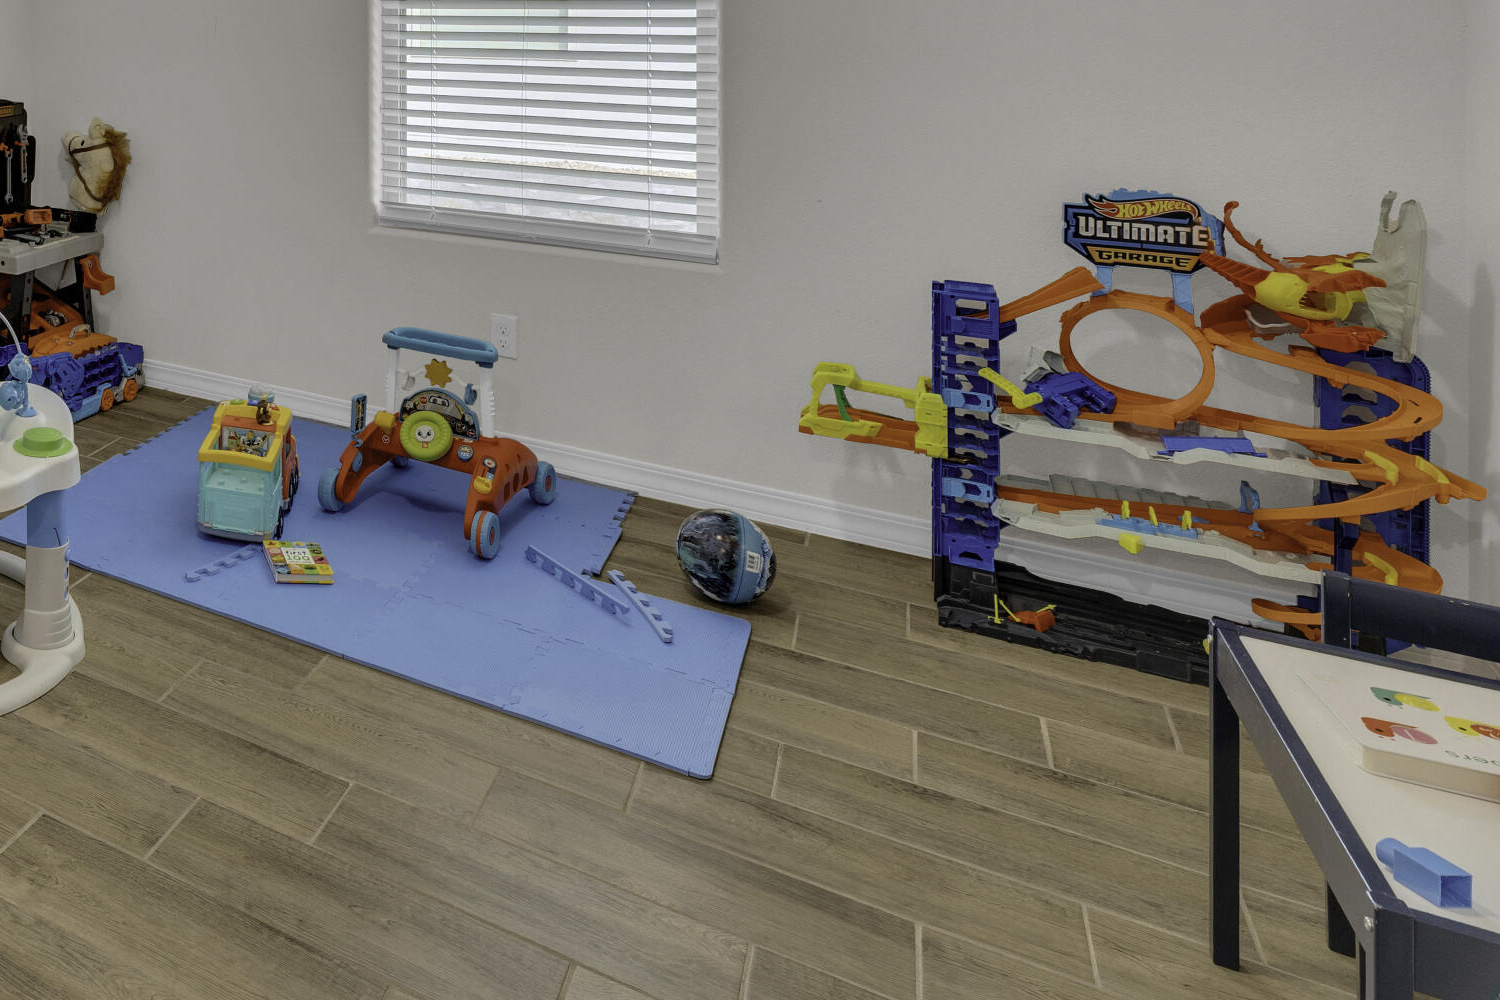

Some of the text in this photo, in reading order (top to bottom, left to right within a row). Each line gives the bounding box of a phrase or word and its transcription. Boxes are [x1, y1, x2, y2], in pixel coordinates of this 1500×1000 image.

[1117, 203, 1148, 218] HOT
[1077, 215, 1210, 246] ULTIMATE
[1095, 250, 1192, 268] GARAGE
